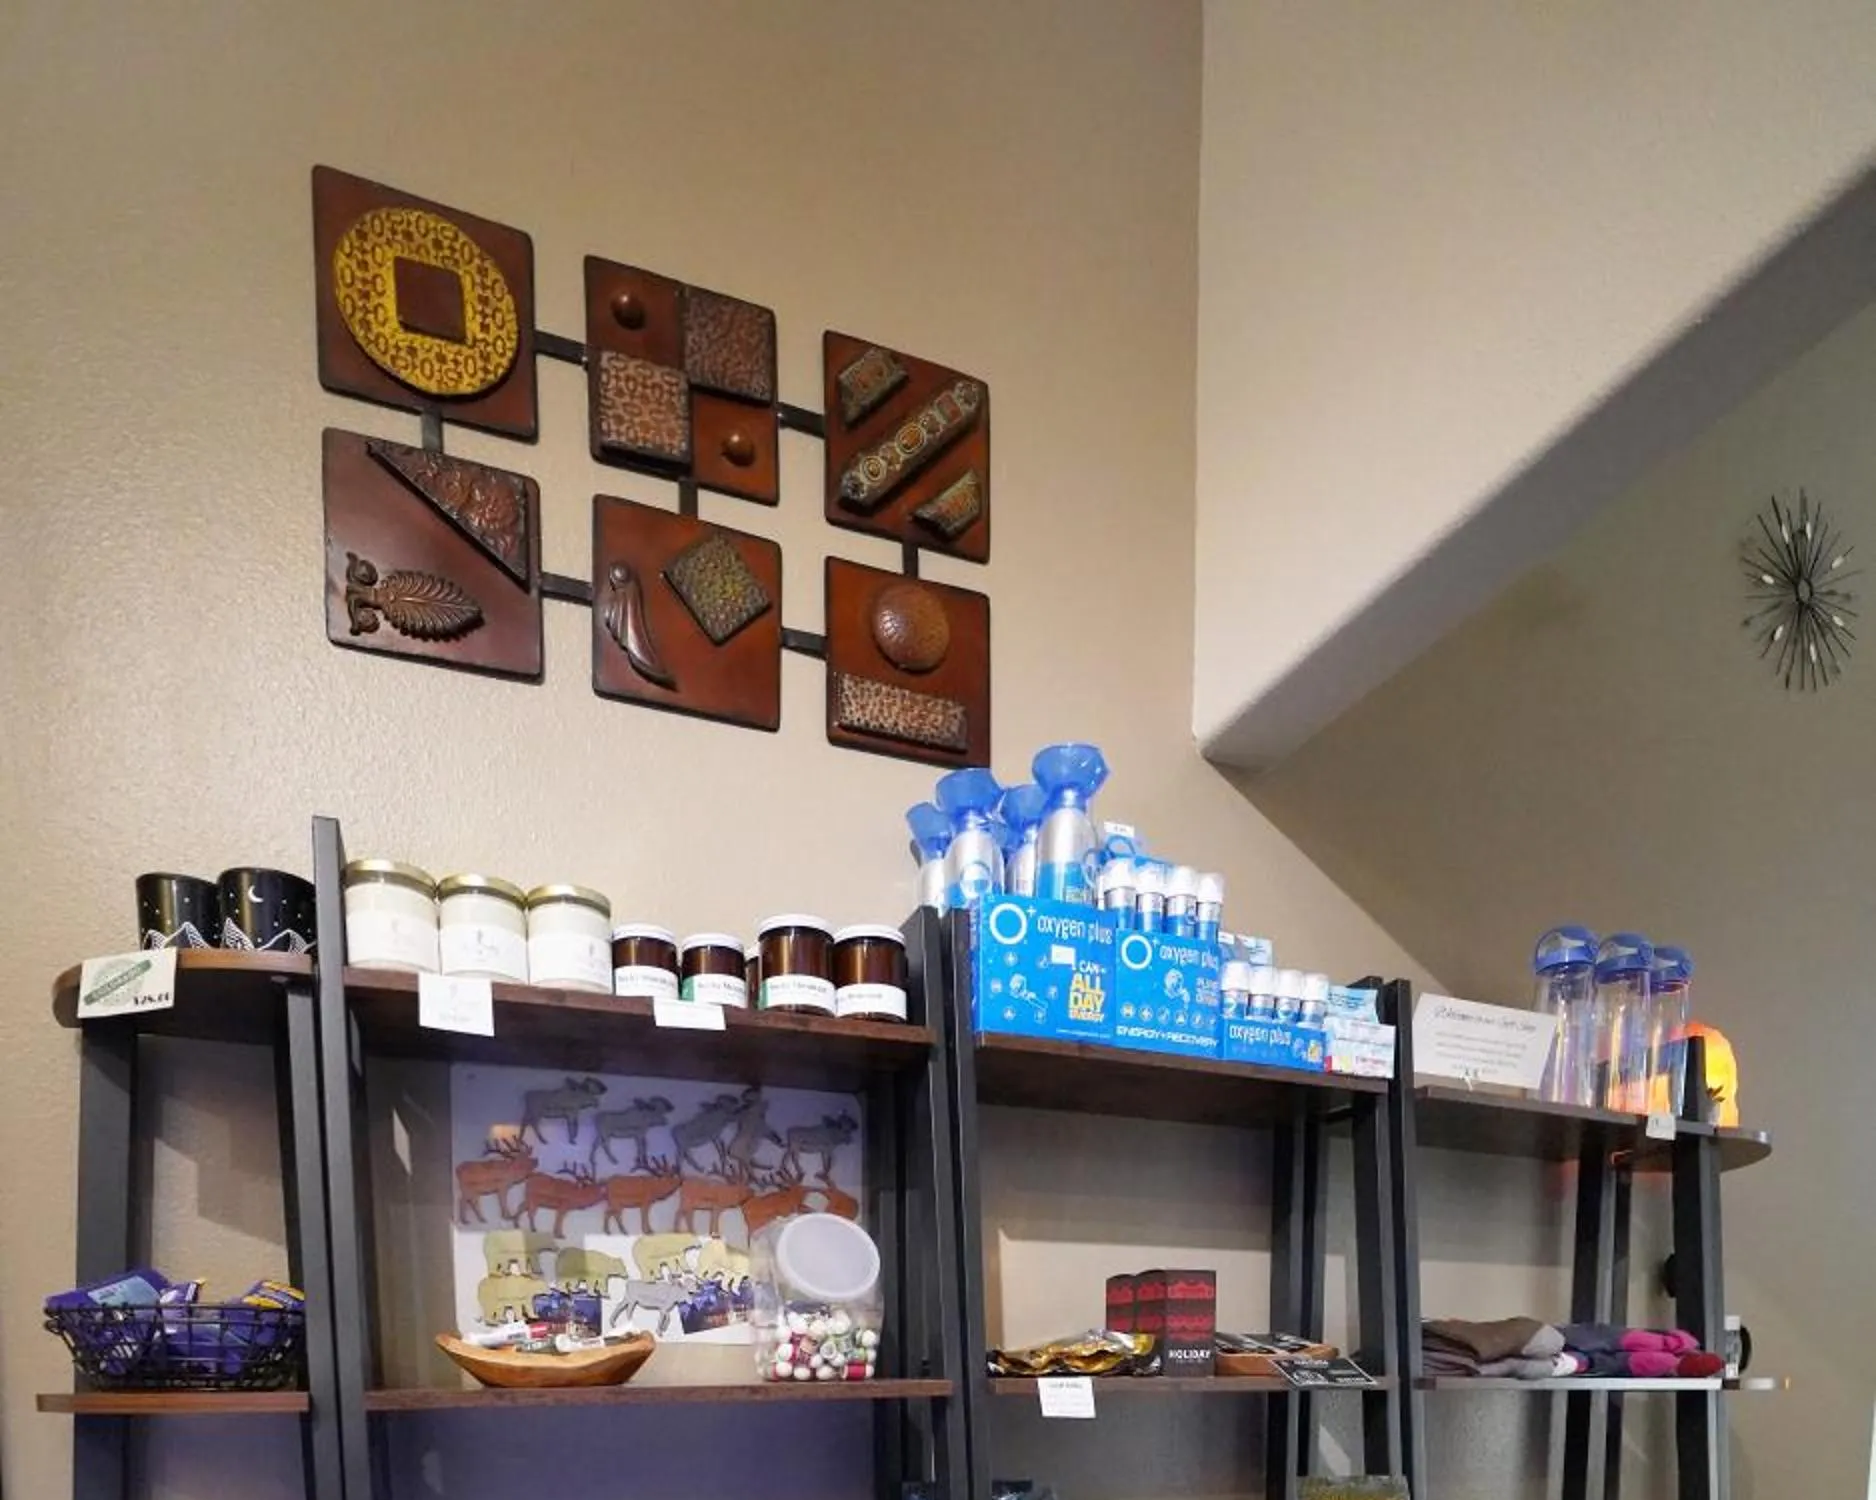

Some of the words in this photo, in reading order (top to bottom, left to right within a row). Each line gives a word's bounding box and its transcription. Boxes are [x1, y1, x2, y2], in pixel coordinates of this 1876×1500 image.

[1037, 914, 1085, 940] oxygen
[1087, 921, 1113, 945] plus
[1168, 1348, 1211, 1360] HOLIDAY
